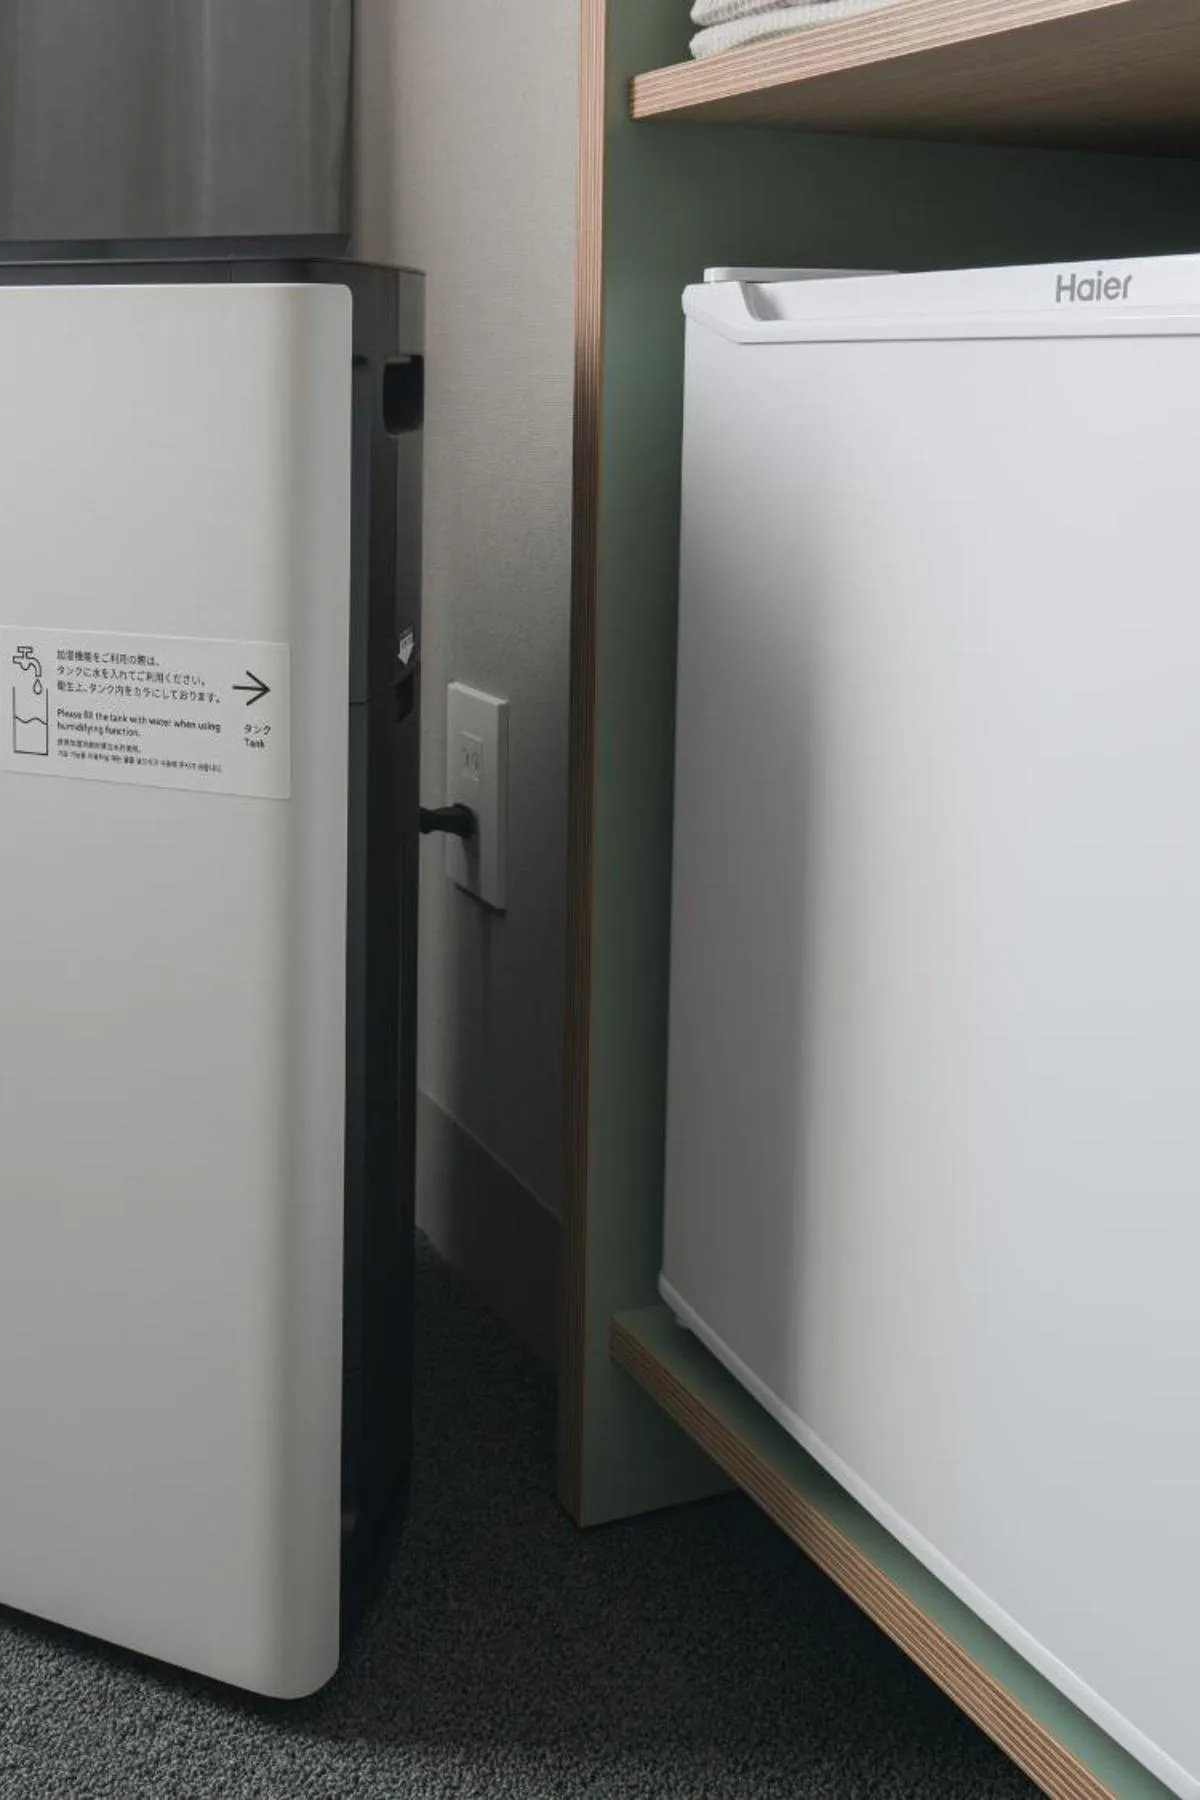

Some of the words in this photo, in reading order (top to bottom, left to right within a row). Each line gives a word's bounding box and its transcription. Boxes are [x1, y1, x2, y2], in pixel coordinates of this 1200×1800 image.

[1055, 270, 1133, 303] Haier
[57, 708, 82, 720] Please
[95, 711, 109, 721] the
[110, 713, 128, 723] tank
[129, 715, 147, 725] with
[148, 717, 172, 728] water
[174, 718, 196, 729] when
[197, 722, 221, 734] using
[57, 720, 104, 736] humidifying
[244, 723, 271, 736] タンク
[244, 737, 265, 749] Tank
